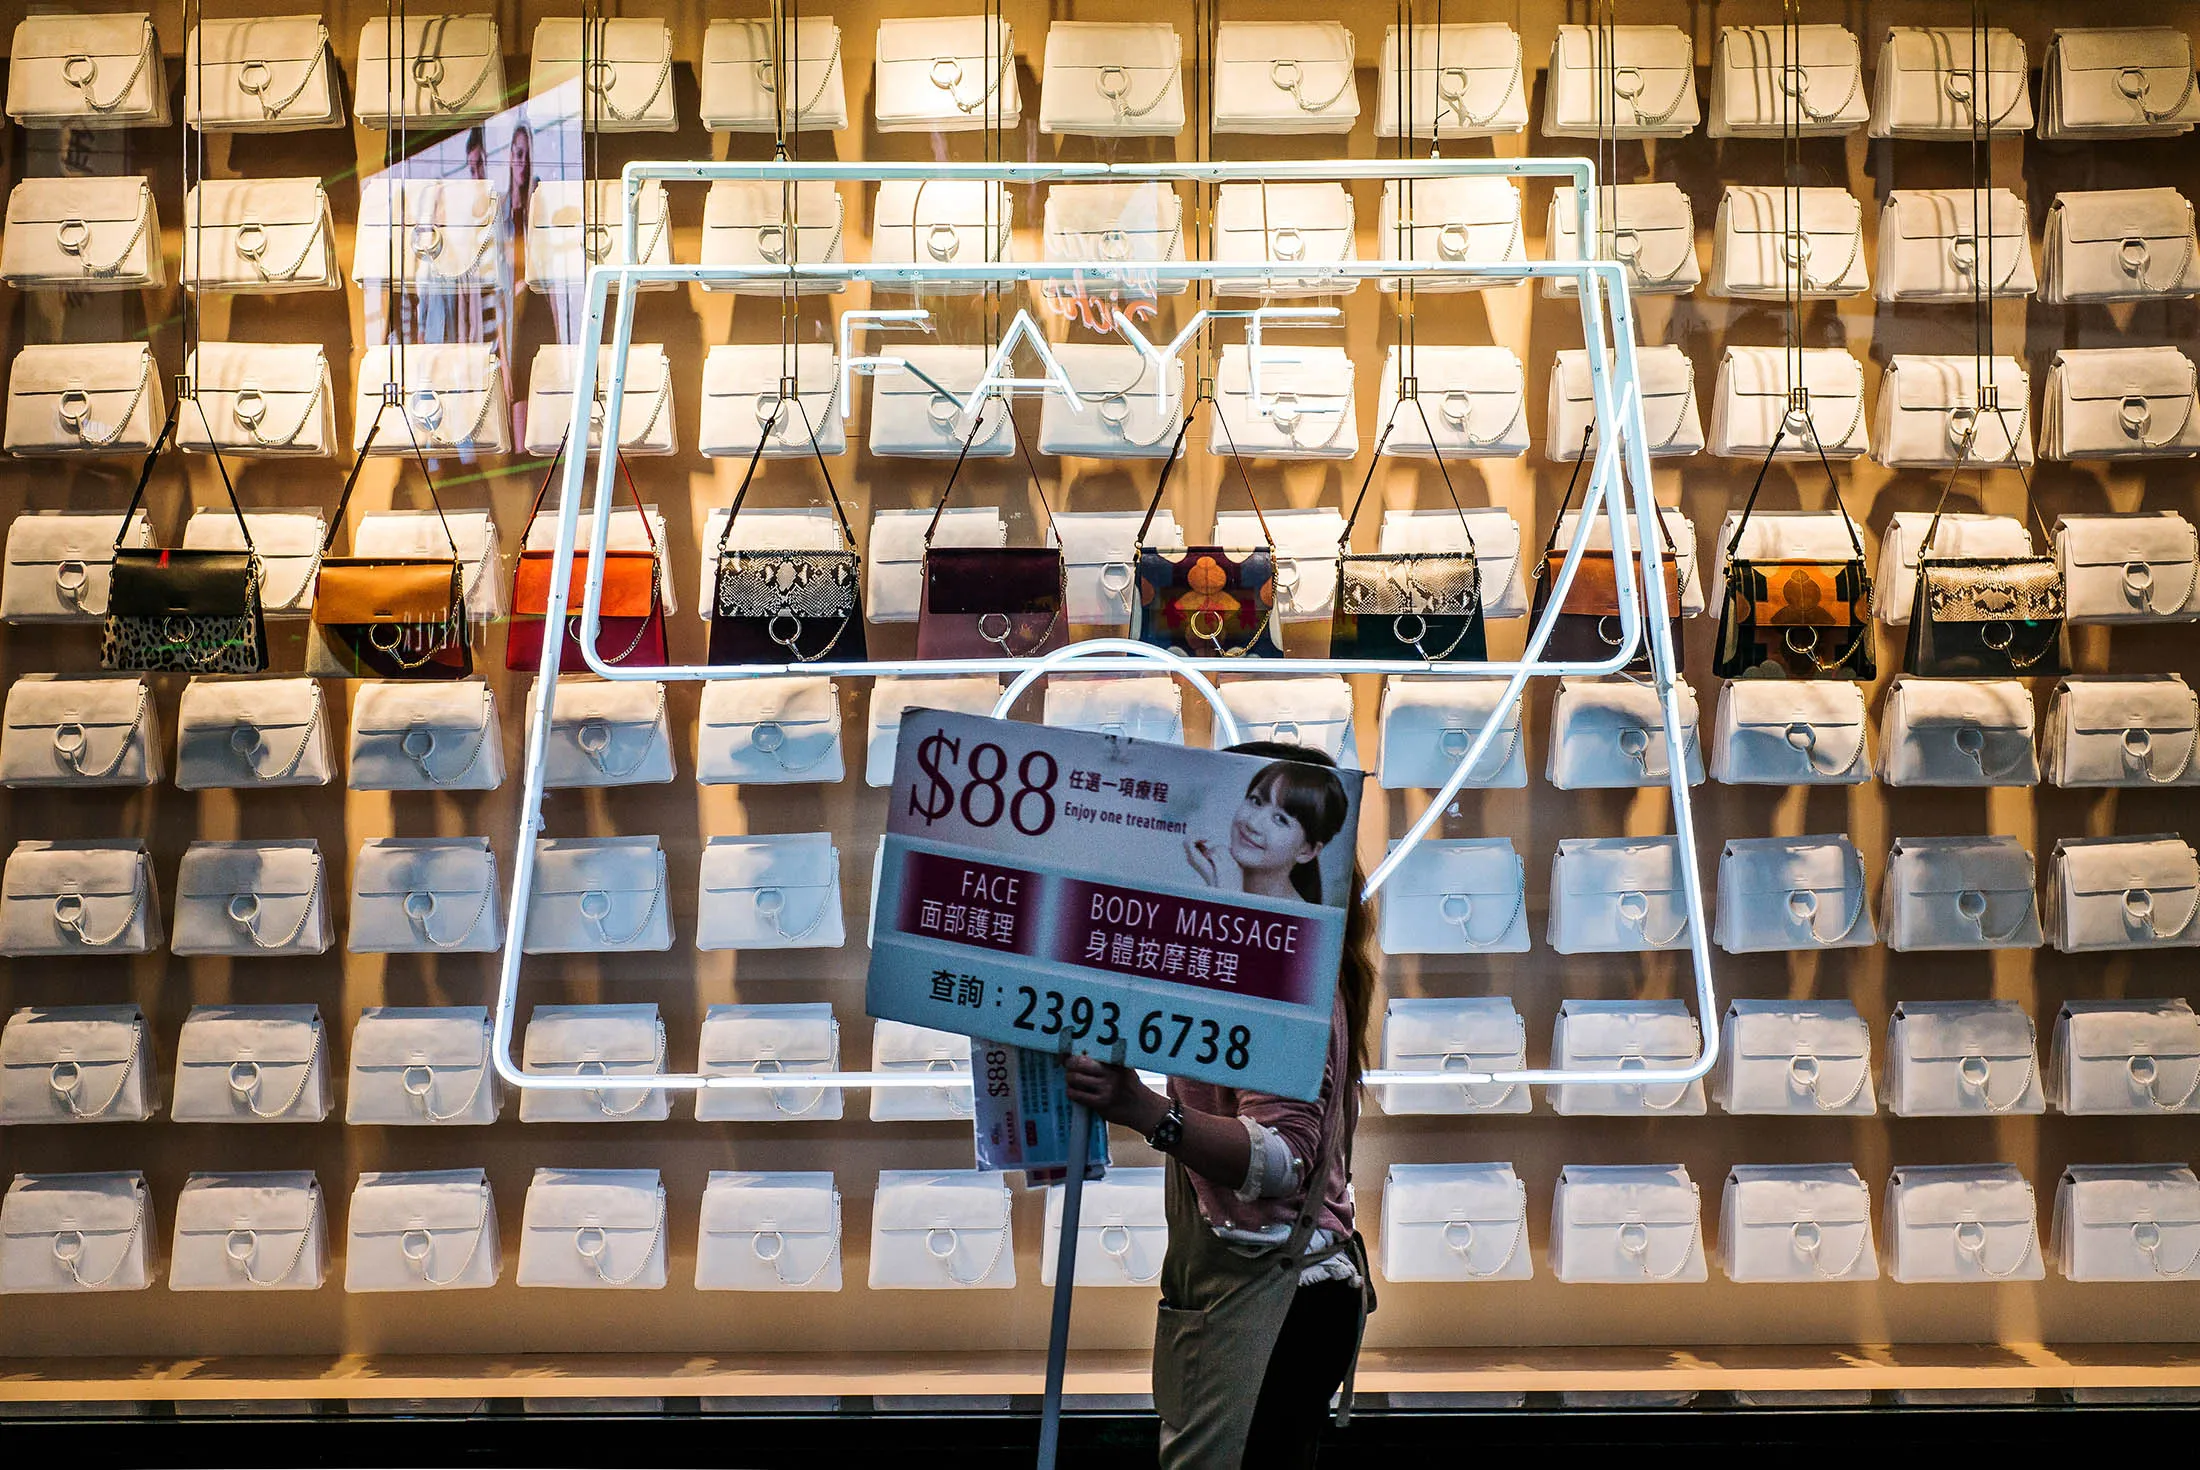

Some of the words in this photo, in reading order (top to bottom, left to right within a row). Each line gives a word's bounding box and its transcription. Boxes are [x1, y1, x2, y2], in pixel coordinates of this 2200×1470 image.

[840, 307, 1342, 417] FAYE
[909, 728, 1058, 836] $88
[1069, 769, 1169, 803] 任選一項療程
[1064, 801, 1097, 823] Enjoy
[1100, 811, 1122, 824] one
[1126, 813, 1187, 834] treatment
[961, 870, 1019, 906] FACE
[920, 899, 1014, 944] 面部護理
[1090, 893, 1160, 930] BODY
[1175, 907, 1299, 954] MASSAGE
[1085, 929, 1239, 984] 身體按摩護理
[1013, 985, 1120, 1046] 2393
[1138, 1010, 1250, 1071] 6738
[986, 1050, 1010, 1097] $88
